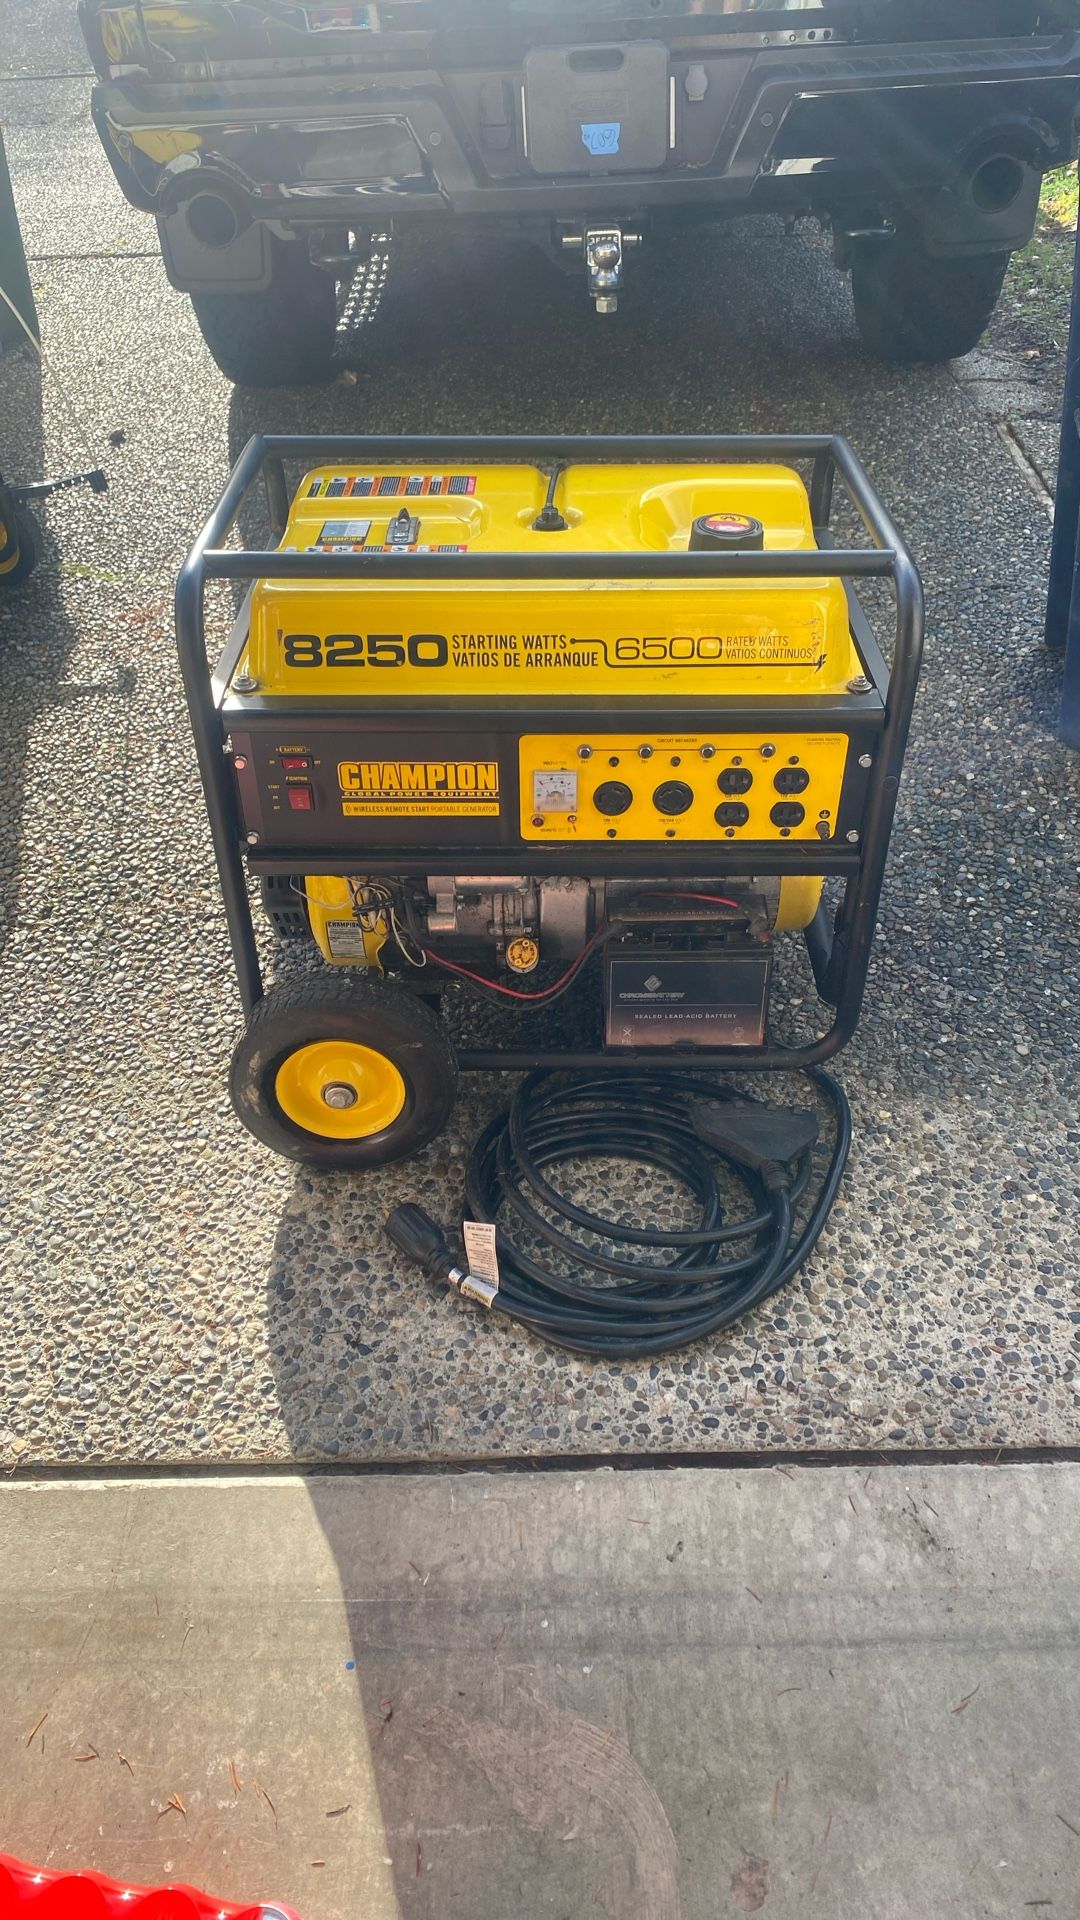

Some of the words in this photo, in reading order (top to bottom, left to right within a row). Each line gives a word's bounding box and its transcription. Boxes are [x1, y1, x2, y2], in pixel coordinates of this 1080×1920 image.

[452, 634, 517, 650] STARTING
[521, 634, 567, 650] WATTS
[615, 636, 723, 660] 6500
[726, 635, 756, 647] RATED
[758, 635, 789, 647] WATTS
[283, 634, 449, 667] 8250
[725, 648, 757, 660] VATIOS
[758, 647, 814, 660] CONTINUOS
[452, 651, 499, 668] VATIOS
[503, 652, 521, 667] DE
[525, 651, 599, 668] ARRANQUE
[338, 762, 498, 791] CHAMPION
[353, 805, 385, 814] WIRELESS
[385, 805, 410, 814] REMOTE
[410, 805, 430, 814] START
[431, 805, 461, 813] PORTABLE
[462, 805, 498, 813] GENERATOR
